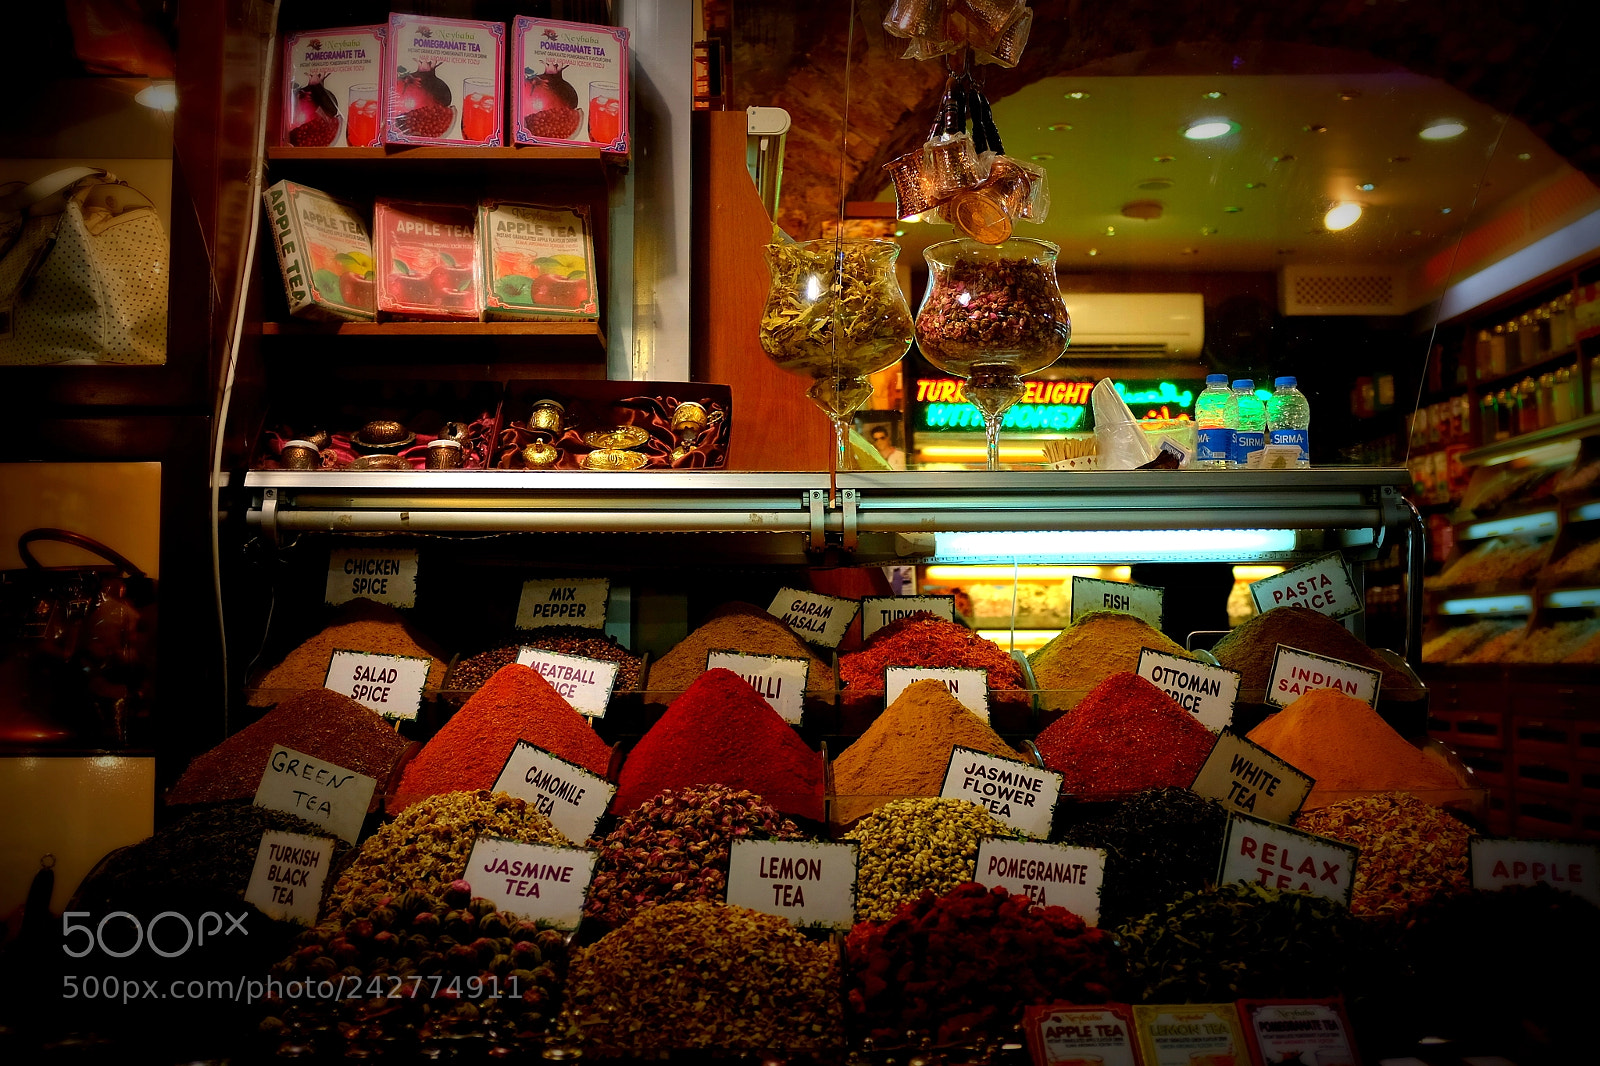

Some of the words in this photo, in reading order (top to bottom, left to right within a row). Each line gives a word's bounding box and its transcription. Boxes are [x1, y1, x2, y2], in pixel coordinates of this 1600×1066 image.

[305, 50, 352, 60] POMEGRANATE
[354, 49, 366, 58] TEA
[413, 38, 466, 51] POMEGRANATE
[468, 43, 480, 52] TEA
[540, 41, 591, 55] POMEGRANATE
[593, 46, 605, 56] TEA
[303, 209, 338, 230] APPLE
[341, 220, 364, 236] TEA
[396, 220, 440, 236] APPLE
[444, 224, 472, 237] TEA
[497, 220, 543, 236] APPLE
[548, 226, 577, 238] TEA
[270, 189, 295, 258] APPLE
[287, 259, 306, 306] TEA
[916, 379, 967, 402] TURK
[1020, 381, 1094, 405] ELIGHT
[1238, 436, 1264, 446] SIRMA
[1273, 434, 1304, 444] SIRMA
[344, 559, 400, 575] CHICKEN
[352, 578, 388, 594] SPICE
[549, 587, 577, 601] MIX
[1273, 573, 1332, 604] PASTA
[533, 603, 587, 618] PEPPER
[790, 600, 834, 618] GARAM
[1103, 593, 1130, 610] FISH
[1291, 590, 1336, 609] ICE
[780, 612, 827, 634] MASALA
[353, 665, 398, 684] SALAD
[529, 660, 596, 685] MEATBALL
[1151, 665, 1221, 697] OTTOMAN
[1291, 666, 1358, 696] INDIAN
[350, 684, 391, 702] SPICE
[548, 680, 578, 698] ICE
[740, 674, 782, 699] ILLI
[271, 751, 355, 788] GREEN
[964, 762, 1044, 793] JASMINE
[1229, 754, 1282, 797] WHITE
[525, 766, 586, 807] CAMOMILE
[963, 777, 1036, 808] FLOWER
[1227, 780, 1257, 812] TEA
[292, 790, 332, 819] TEA
[535, 793, 556, 818] TEA
[980, 797, 1011, 818] TEA
[269, 844, 320, 868] TURKISH
[1240, 836, 1340, 885] RELAX
[267, 865, 310, 887] BLACK
[484, 858, 574, 882] JASMINE
[759, 856, 822, 881] LEMON
[988, 856, 1088, 885] POMEGRANATE
[1492, 860, 1583, 882] APPLE
[272, 886, 294, 906] TEA
[506, 879, 540, 899] TEA
[772, 884, 805, 907] TEA
[1022, 884, 1046, 907] TEA
[1046, 1025, 1093, 1038] APPLE
[1095, 1024, 1124, 1037] TEA
[1151, 1024, 1200, 1037] LEMON
[1203, 1023, 1231, 1035] TEA
[1258, 1020, 1322, 1032] POMEGRANATE
[1325, 1020, 1340, 1031] TEA
